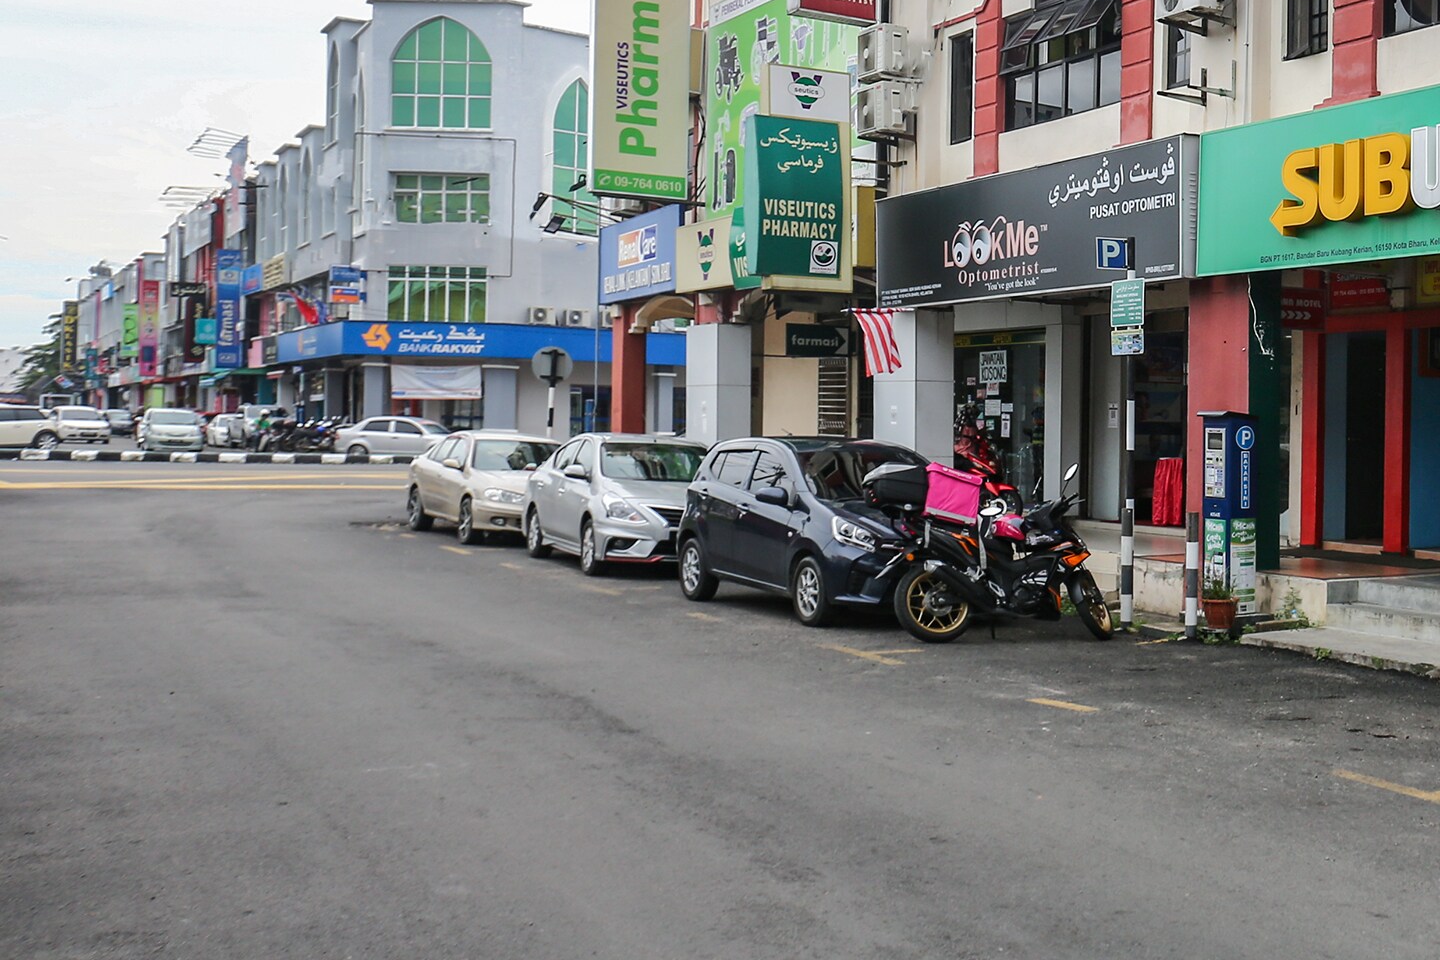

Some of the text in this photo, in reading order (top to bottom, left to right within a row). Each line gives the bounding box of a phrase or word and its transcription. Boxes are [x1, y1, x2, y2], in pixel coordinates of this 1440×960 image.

[615, 41, 629, 110] VISEUTICS
[777, 155, 824, 174] فرماسي
[614, 176, 682, 192] 09-764 0610
[763, 198, 836, 220] VISEUTICS
[1090, 192, 1175, 219] PUSAT OPTOMETRI
[762, 219, 837, 240] PHARMACY
[1102, 240, 1121, 267] P
[1260, 255, 1273, 264] BGN
[1273, 254, 1281, 263] PT
[1296, 251, 1316, 260] Bandar
[1317, 249, 1330, 258] Baru
[1330, 247, 1352, 258] Kubang
[1353, 245, 1374, 255] Kerian,
[1375, 242, 1392, 252] 16150
[1393, 241, 1407, 250] Kota
[1408, 239, 1428, 249] Bharu,
[958, 261, 1039, 287] Optometrist
[1295, 298, 1322, 309] MOTEL
[791, 336, 839, 347] farmasi
[981, 352, 1005, 366] JAWATAN
[981, 365, 1007, 381] KOSONG
[1241, 430, 1251, 446] P
